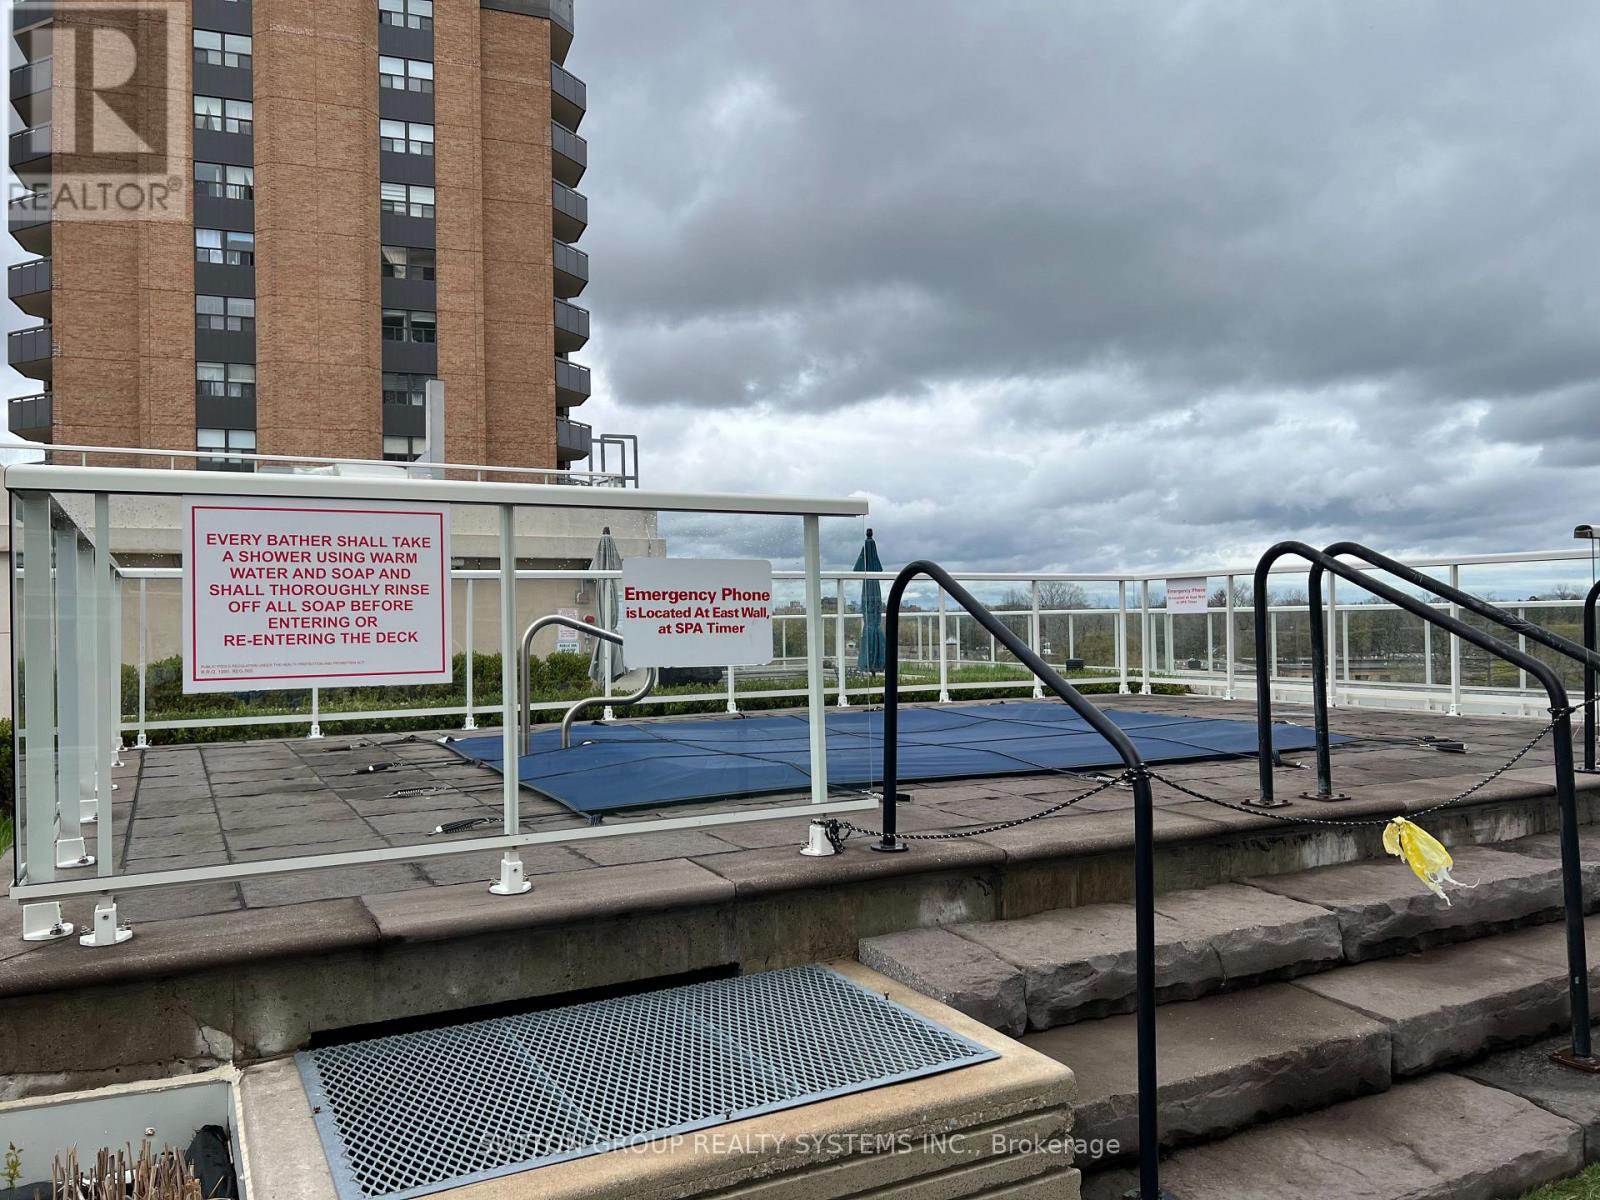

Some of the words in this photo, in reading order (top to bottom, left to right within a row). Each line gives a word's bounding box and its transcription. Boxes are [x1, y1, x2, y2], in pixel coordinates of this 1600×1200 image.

[206, 533, 262, 546] EVERY
[267, 534, 332, 547] BATHER
[337, 535, 387, 548] SHALL
[392, 536, 431, 549] TAKE
[222, 551, 234, 563] A
[238, 550, 312, 563] SHOWER
[317, 551, 365, 564] USING
[370, 552, 417, 564] WARM
[230, 567, 287, 579] WATER
[292, 567, 326, 579] AND
[331, 568, 375, 580] SOAP
[379, 568, 411, 579] AND
[209, 584, 264, 596] SHALL
[269, 583, 379, 596] THOROUGHLY
[384, 584, 430, 595] RINSE
[624, 586, 717, 604] Emergency
[721, 587, 770, 601] Phone
[228, 600, 261, 613] OFF
[265, 600, 296, 612] ALL
[301, 600, 346, 612] SOAP
[351, 600, 413, 611] BEFORE
[626, 607, 637, 618] is
[638, 607, 690, 619] Located
[694, 607, 711, 618] At
[713, 607, 739, 618] East
[741, 607, 770, 620] Wall,
[268, 616, 350, 629] ENTERING
[355, 616, 378, 628] OR
[658, 623, 672, 634] at
[675, 623, 703, 634] SPA
[706, 622, 745, 634] Timer
[224, 633, 336, 646] RE-ENTERING
[340, 632, 371, 644] THE
[376, 631, 418, 643] DECK
